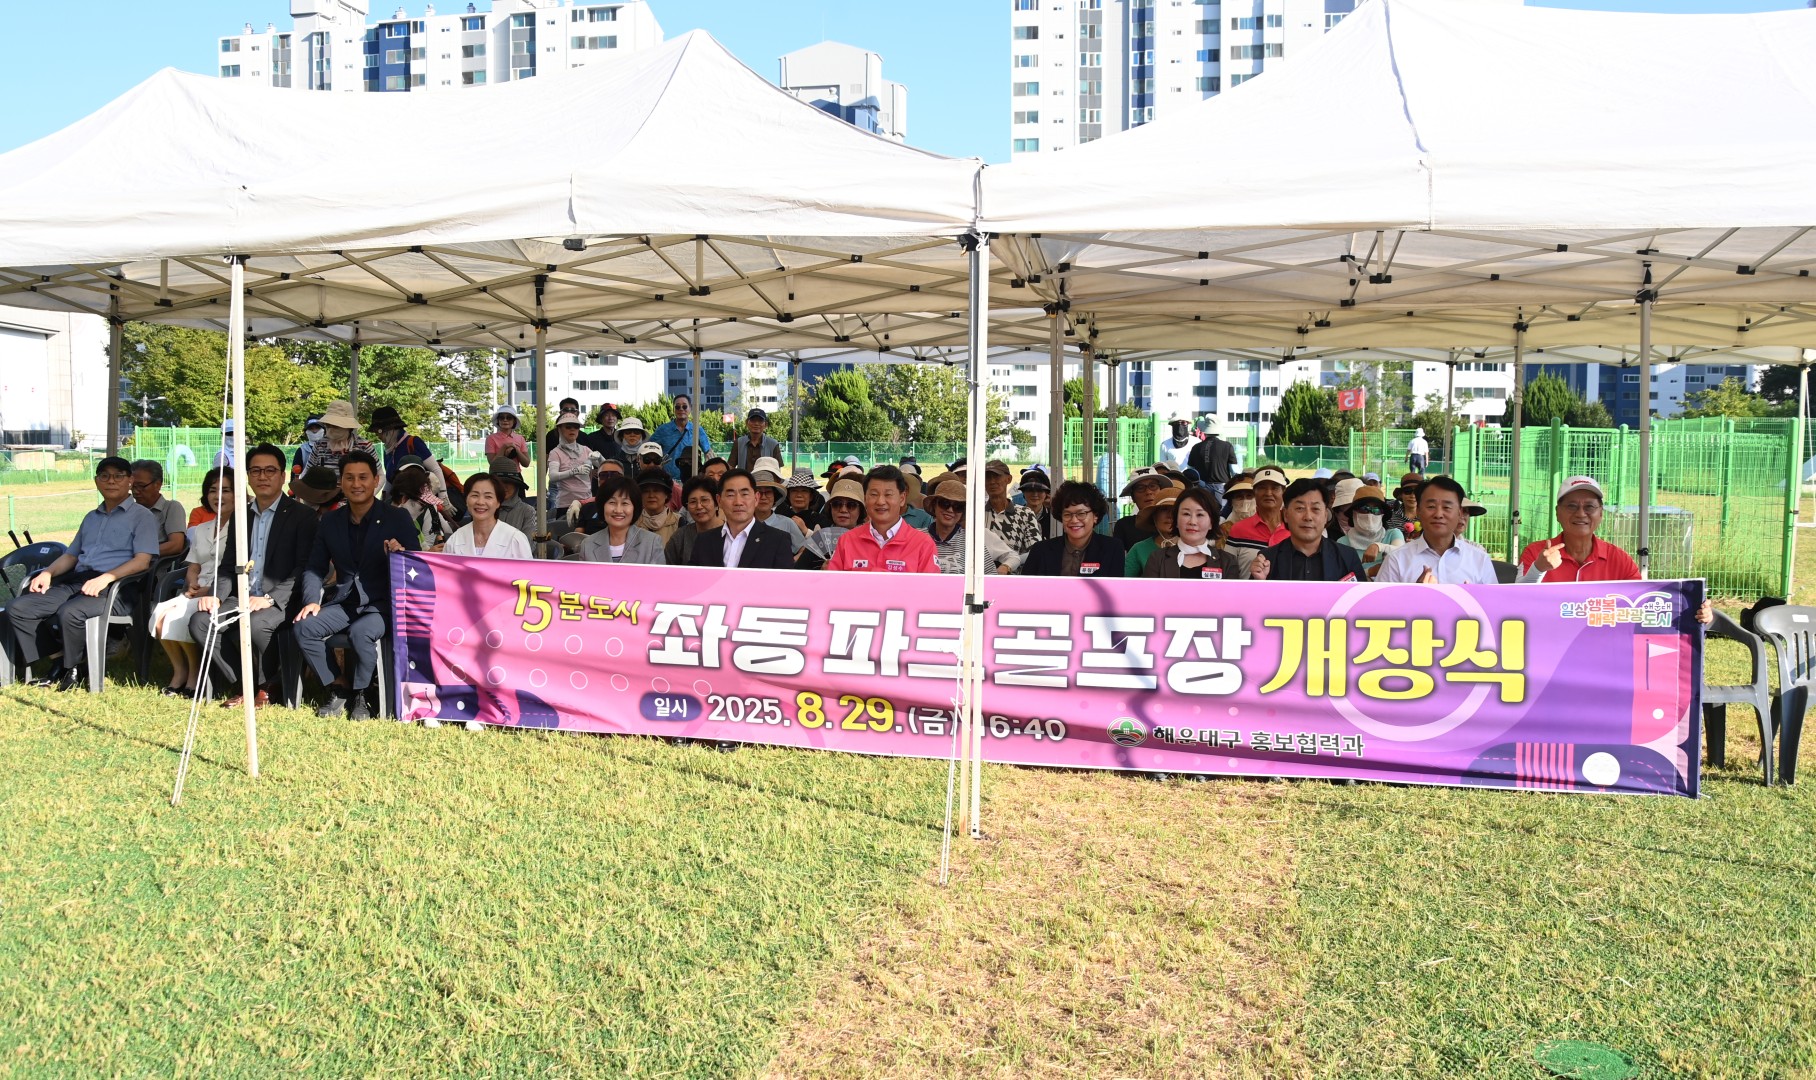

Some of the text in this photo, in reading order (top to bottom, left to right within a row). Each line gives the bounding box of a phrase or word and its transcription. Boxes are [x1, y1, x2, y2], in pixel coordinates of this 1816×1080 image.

[648, 603, 1526, 702] 좌동 파크골프장 개장식
[654, 697, 688, 718] 일시
[1153, 726, 1365, 757] 해운대구 홍보협력과
